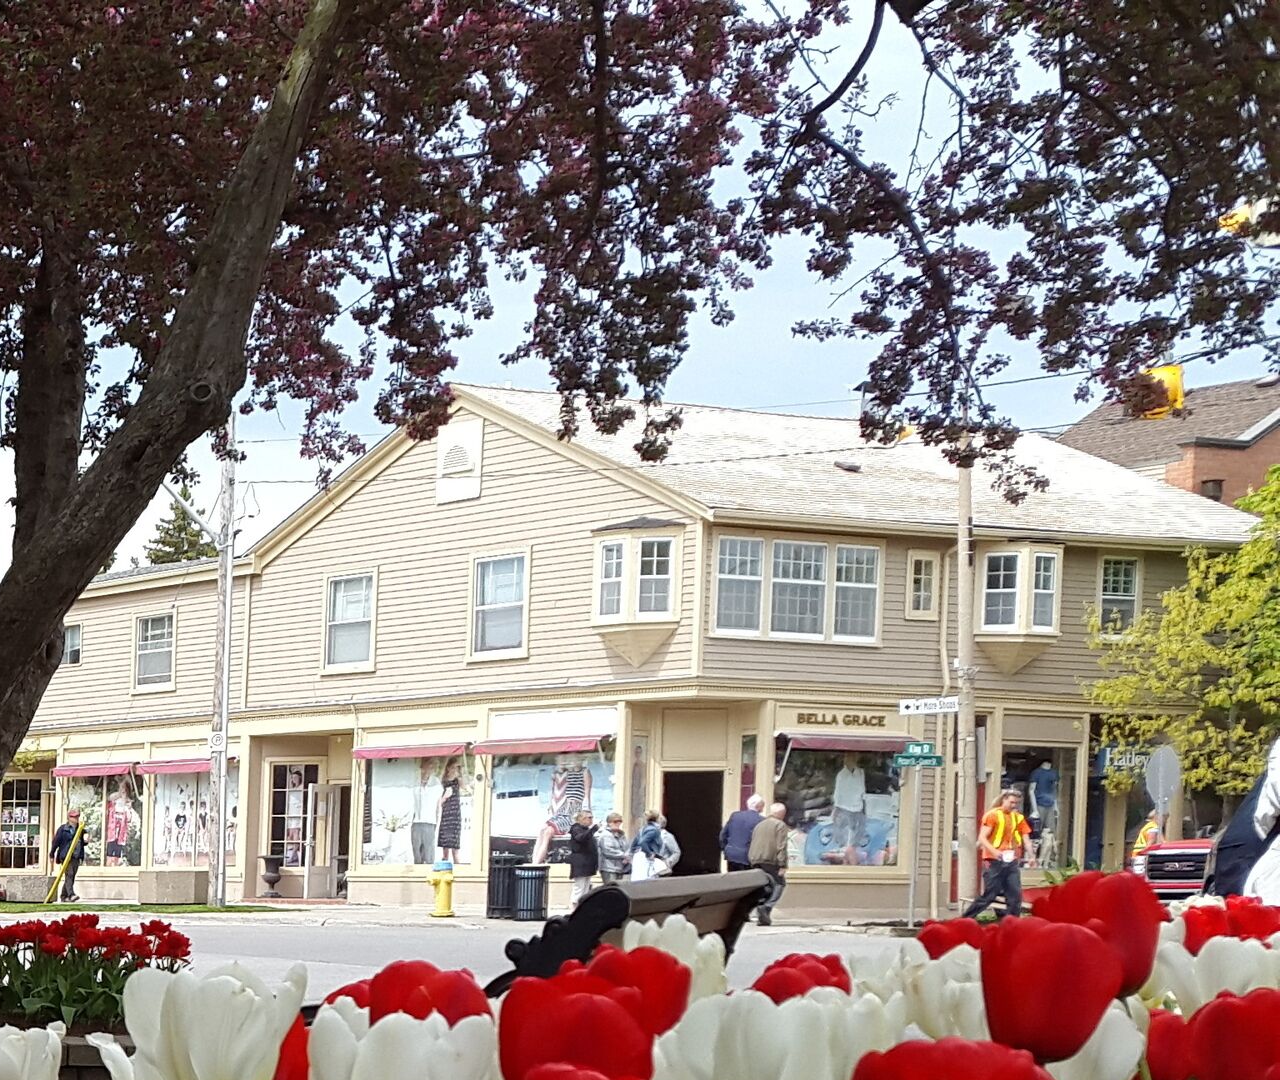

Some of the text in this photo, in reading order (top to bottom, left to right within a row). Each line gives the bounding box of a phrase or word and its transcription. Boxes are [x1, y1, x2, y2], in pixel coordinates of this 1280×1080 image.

[797, 713, 886, 727] BELLA GRACE
[1105, 747, 1151, 770] Hatley
